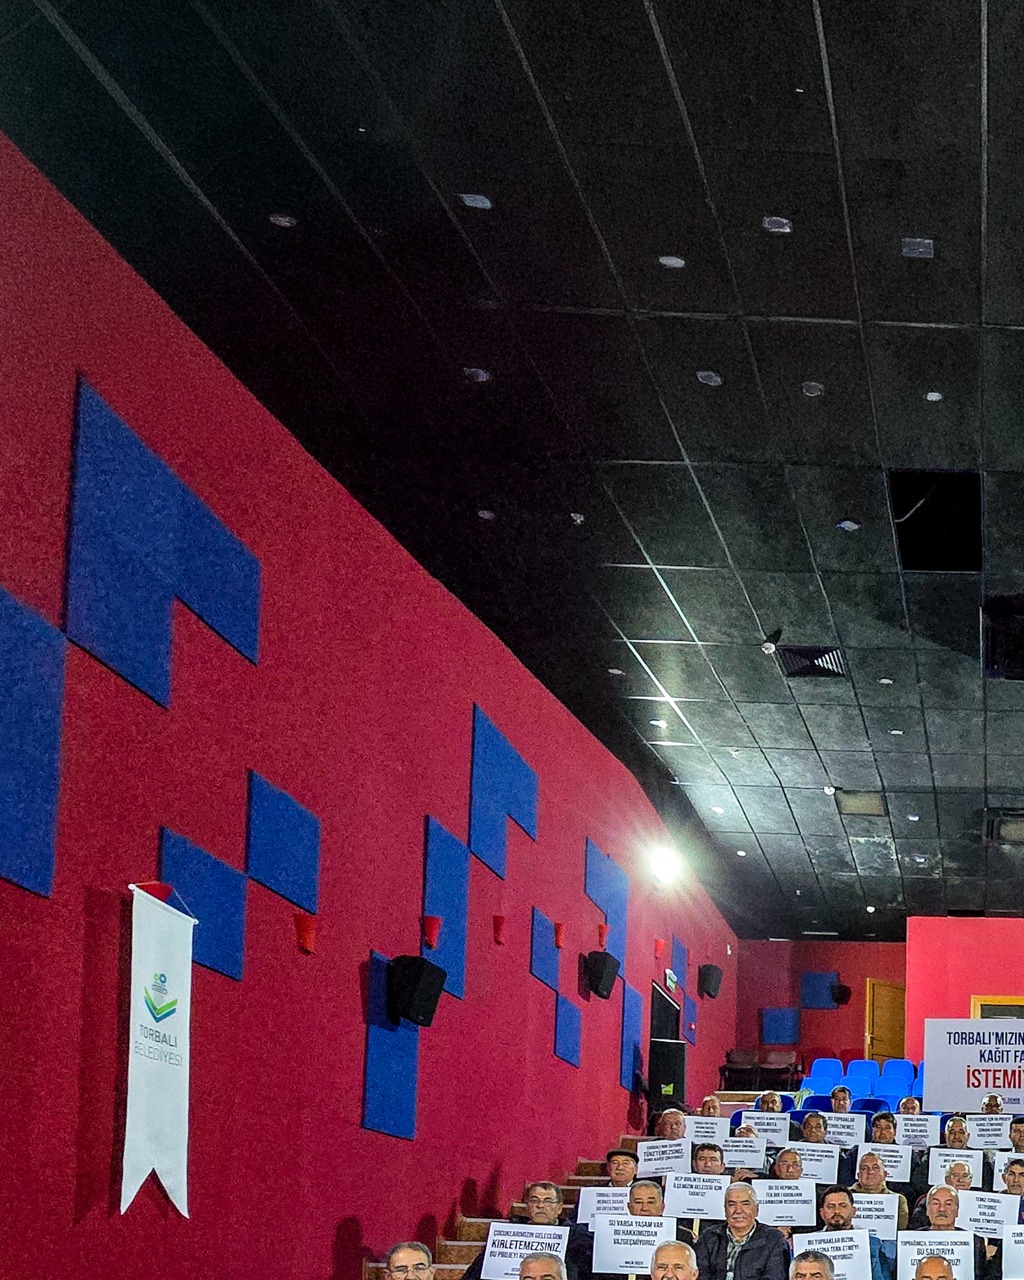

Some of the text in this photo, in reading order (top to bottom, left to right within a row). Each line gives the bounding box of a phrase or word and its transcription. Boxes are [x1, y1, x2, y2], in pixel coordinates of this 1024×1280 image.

[139, 1024, 178, 1048] TORBALI
[947, 1031, 1024, 1046] TORBALI'MIZIN
[134, 1040, 183, 1067] BELEDİYESİ
[979, 1047, 1011, 1063] KAĞIT
